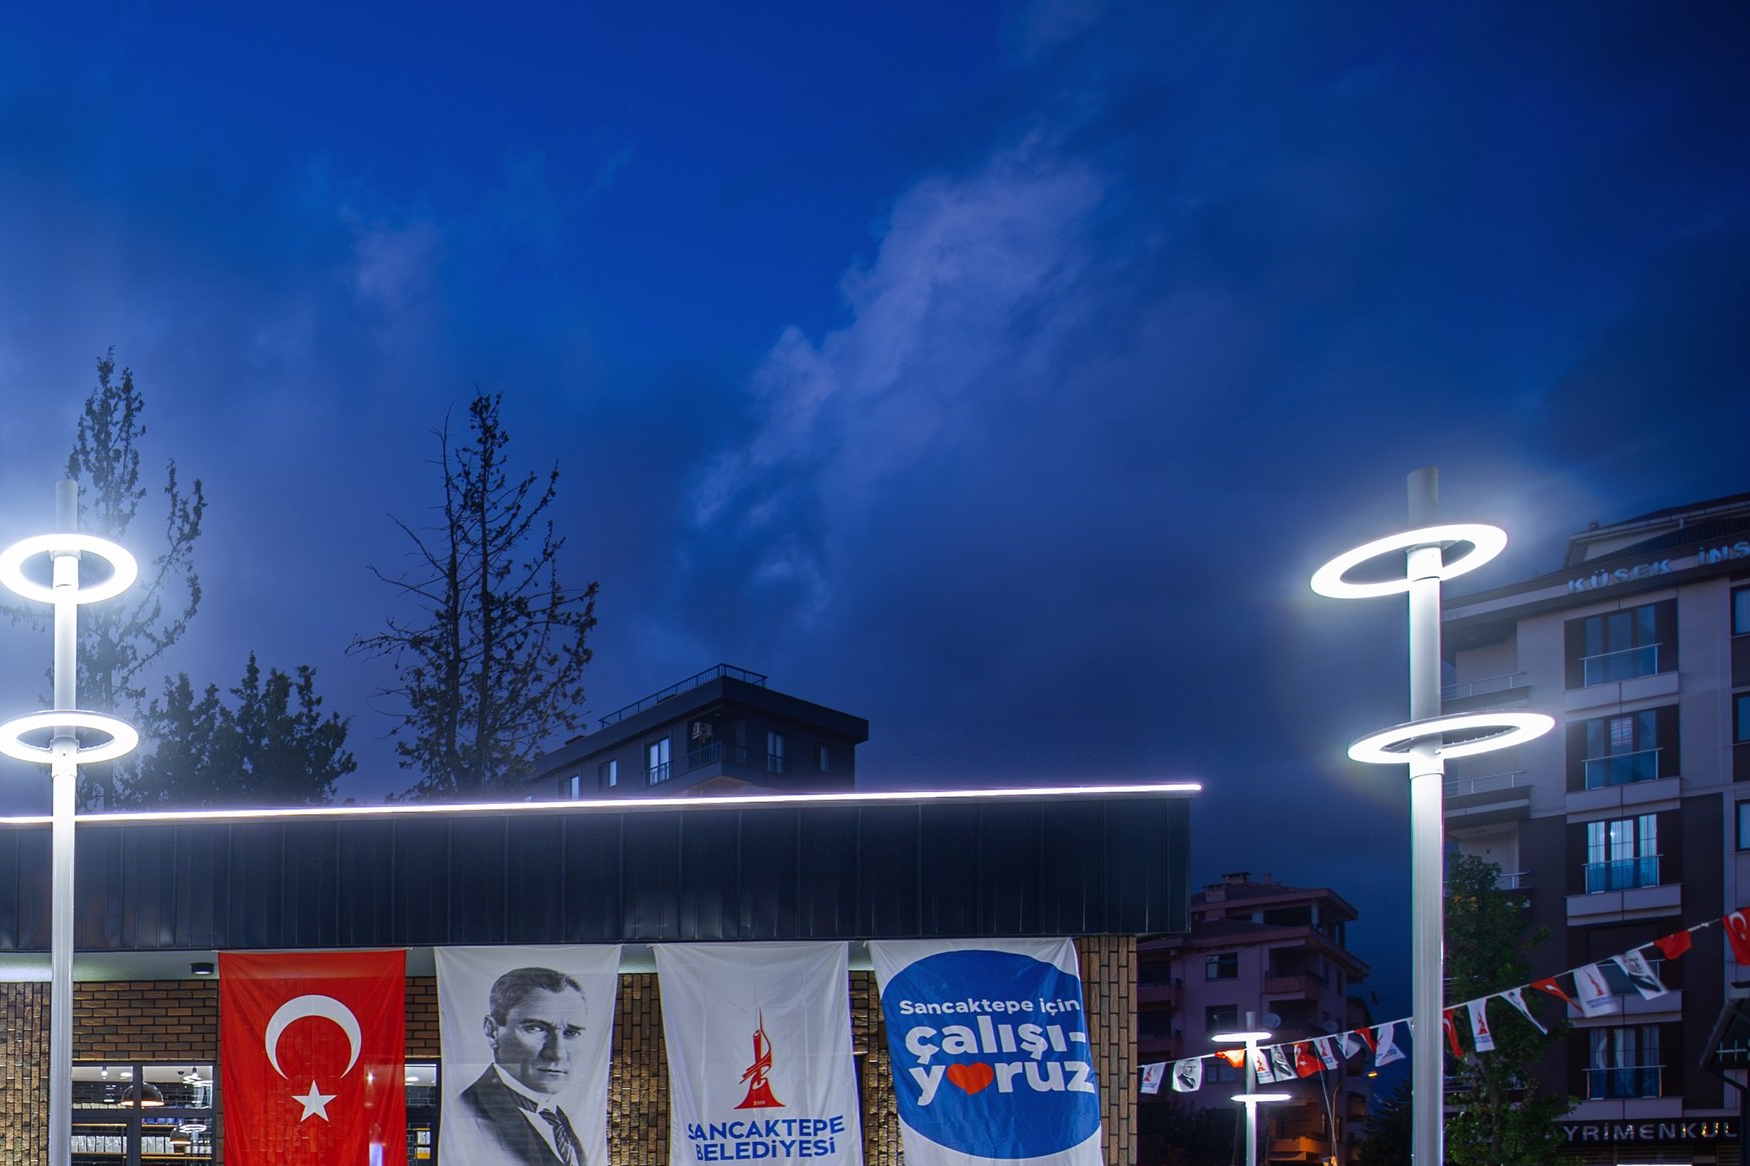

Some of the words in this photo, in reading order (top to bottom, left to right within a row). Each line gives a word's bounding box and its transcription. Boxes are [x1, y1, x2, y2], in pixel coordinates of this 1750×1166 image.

[1567, 559, 1675, 593] KÜSEK
[899, 998, 1034, 1015] Sancaktepe
[1039, 997, 1080, 1016] için
[905, 1015, 1086, 1065] çalışı-
[688, 1115, 845, 1141] SANCAKTEPE
